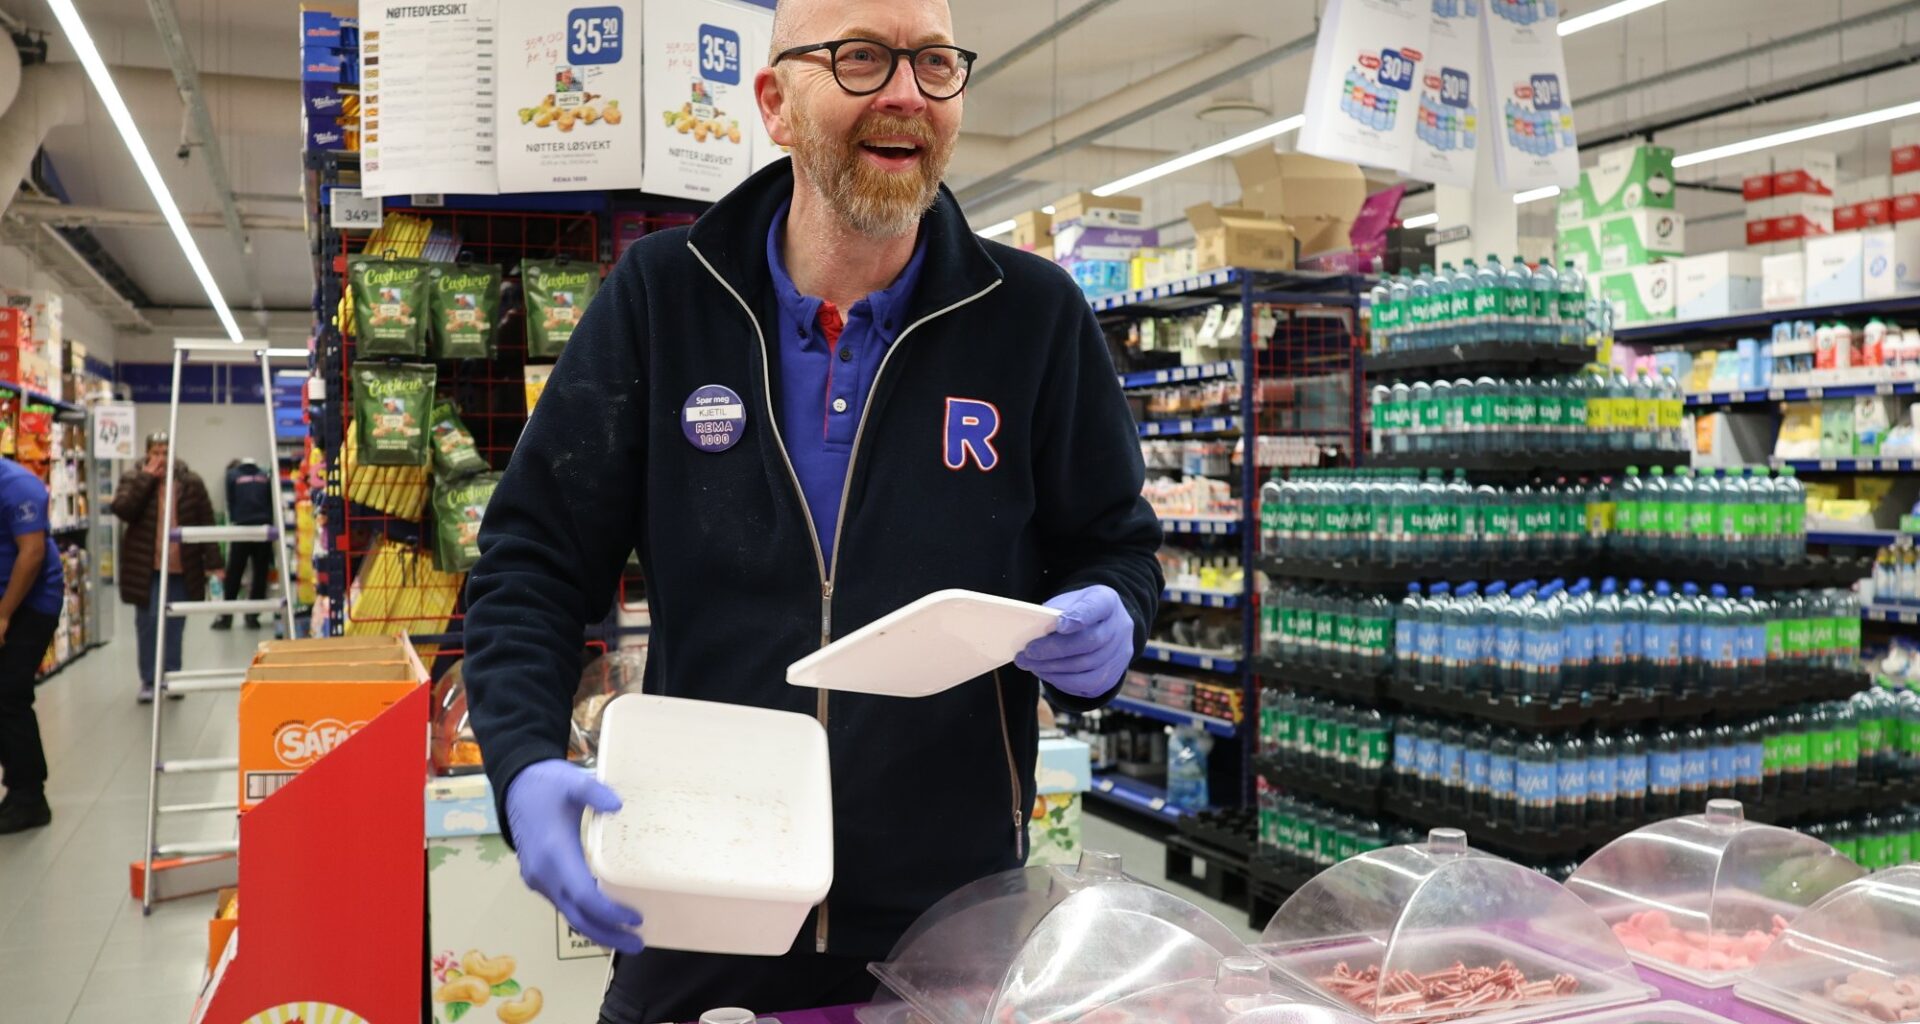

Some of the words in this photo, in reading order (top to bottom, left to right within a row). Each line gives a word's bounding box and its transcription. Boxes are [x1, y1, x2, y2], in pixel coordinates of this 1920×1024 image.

[386, 3, 467, 19] NØTTEOVERSIKT
[572, 18, 601, 55] 35
[603, 17, 618, 34] 90
[702, 34, 726, 73] 35
[1381, 55, 1402, 82] 30
[1443, 73, 1460, 100] 30
[1533, 79, 1551, 105] 30
[526, 141, 565, 153] NØTTER
[567, 140, 612, 151] LØSVEKT
[669, 148, 699, 160] NØTTER
[700, 152, 733, 165] LØSVEKT
[345, 209, 369, 221] 349
[364, 267, 418, 287] Cashew
[439, 273, 491, 292] Cashew
[538, 272, 589, 290] Cashew
[368, 378, 423, 398] Cashew
[696, 396, 713, 405] Spør
[713, 396, 730, 404] meg
[699, 408, 727, 417] KJETIL
[695, 421, 733, 434] REMA
[943, 396, 1001, 471] R
[700, 433, 730, 446] 1000
[281, 726, 360, 760] SAFA
